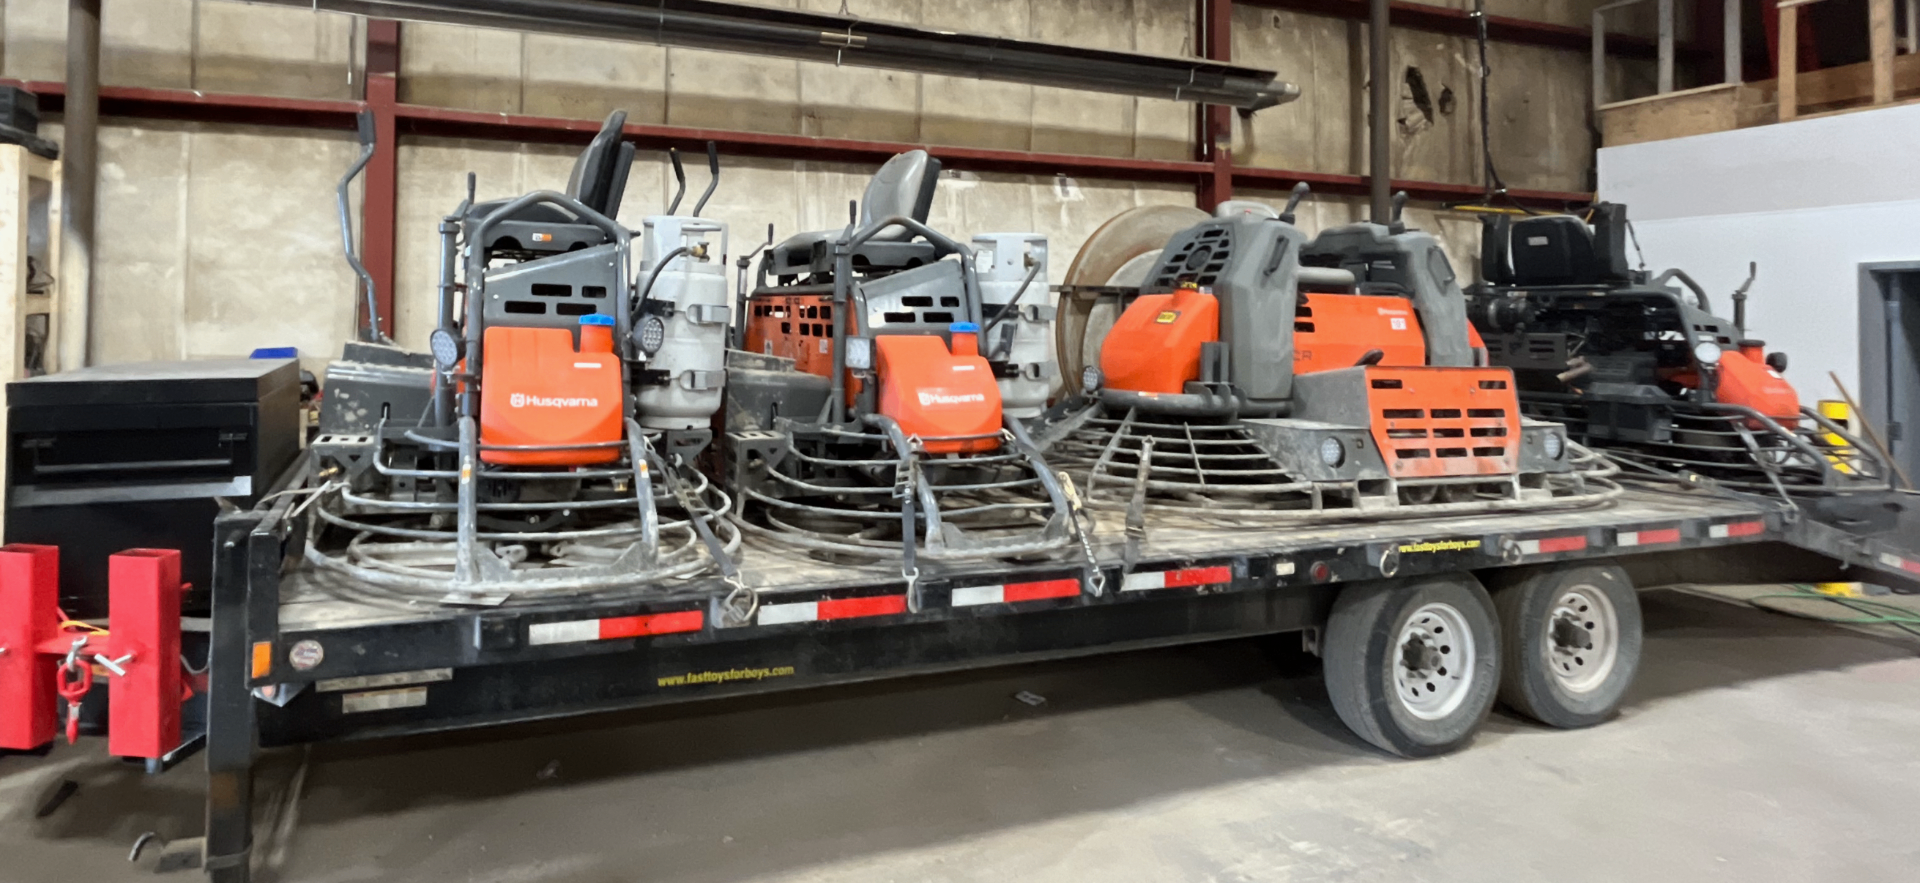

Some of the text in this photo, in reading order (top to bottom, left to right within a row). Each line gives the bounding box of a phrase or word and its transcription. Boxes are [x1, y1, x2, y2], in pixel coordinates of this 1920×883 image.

[526, 395, 598, 408] Husqvarna
[930, 393, 985, 405] Husqvarna
[657, 666, 795, 686] www.fasttoysforboys.com
